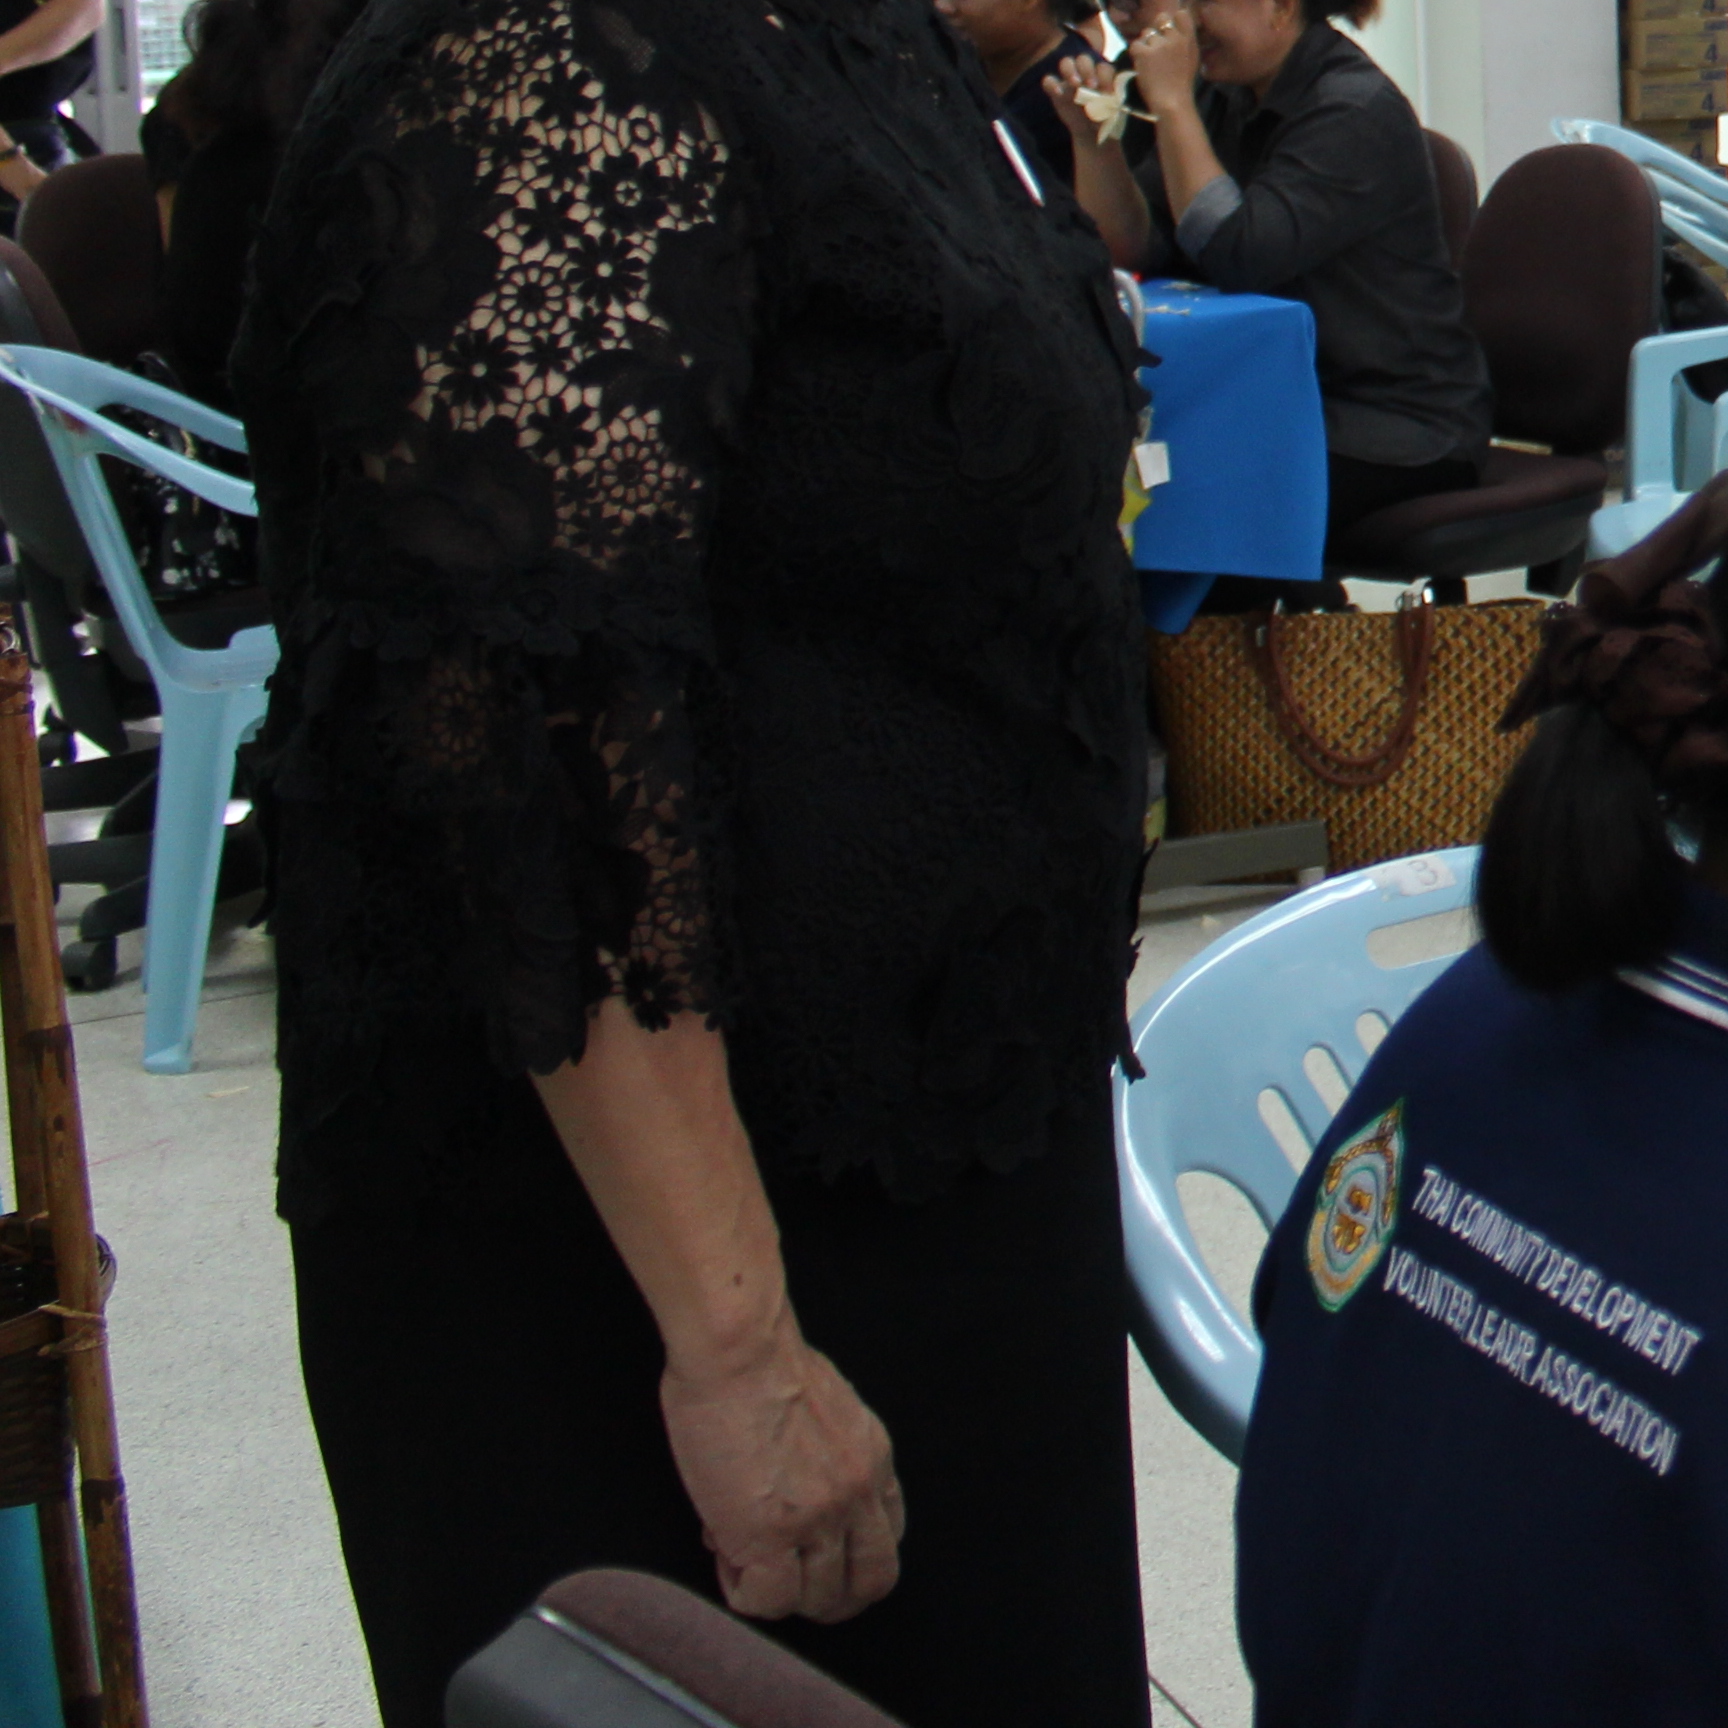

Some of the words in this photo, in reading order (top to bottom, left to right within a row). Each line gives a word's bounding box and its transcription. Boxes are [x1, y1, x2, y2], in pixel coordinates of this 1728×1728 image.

[1411, 1165, 1460, 1228] THAI
[1450, 1193, 1550, 1285] COMMUNITY
[1535, 1247, 1700, 1376] DEVELOPMENT
[1529, 1345, 1677, 1476] ASSOCIATION
